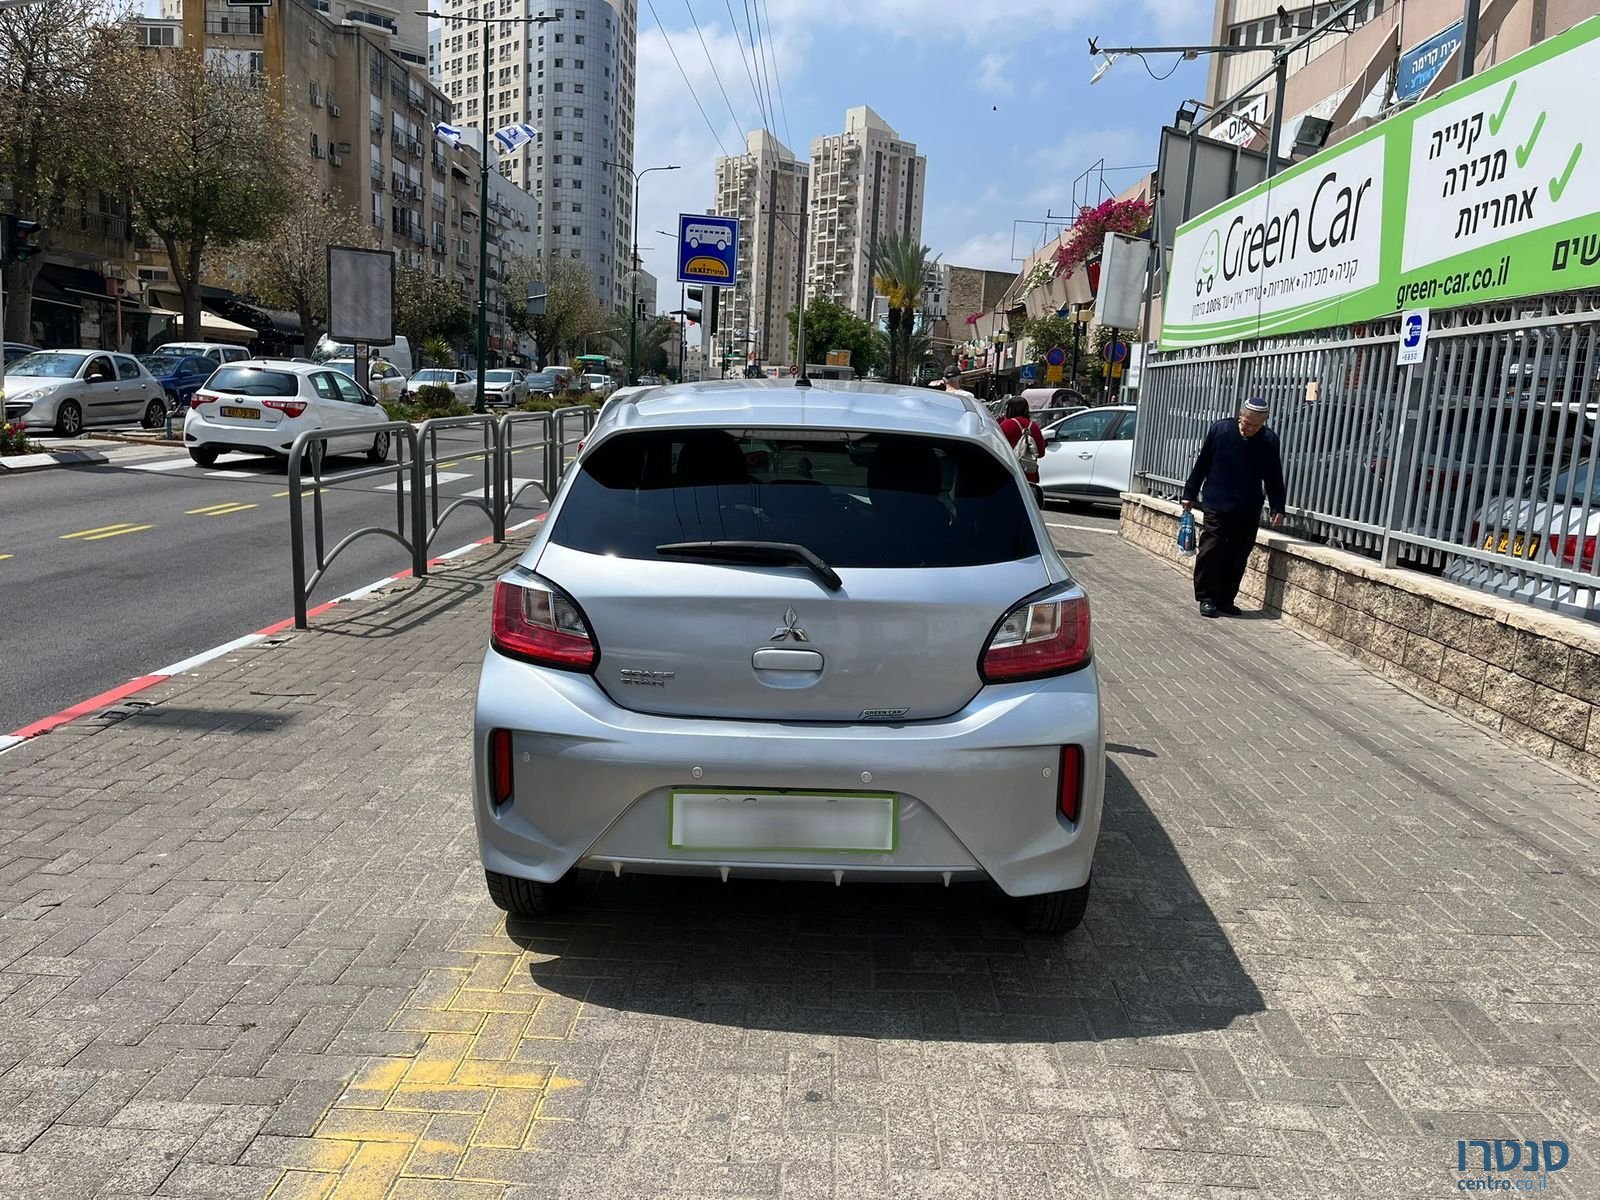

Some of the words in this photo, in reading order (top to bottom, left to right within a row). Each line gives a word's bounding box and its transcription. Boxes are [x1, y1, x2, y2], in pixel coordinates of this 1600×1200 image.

[1440, 39, 1458, 58] בית
[1429, 112, 1484, 160] קנייה
[1442, 149, 1507, 198] מכירה
[1223, 207, 1300, 281] Green
[1307, 172, 1372, 253] Car
[1455, 187, 1539, 239] אחריות
[1267, 276, 1296, 298] אחריות
[1301, 267, 1328, 289] מכירה
[1334, 259, 1359, 284] קניה
[1396, 255, 1510, 310] green-car.co.il
[1206, 297, 1221, 314] 100%
